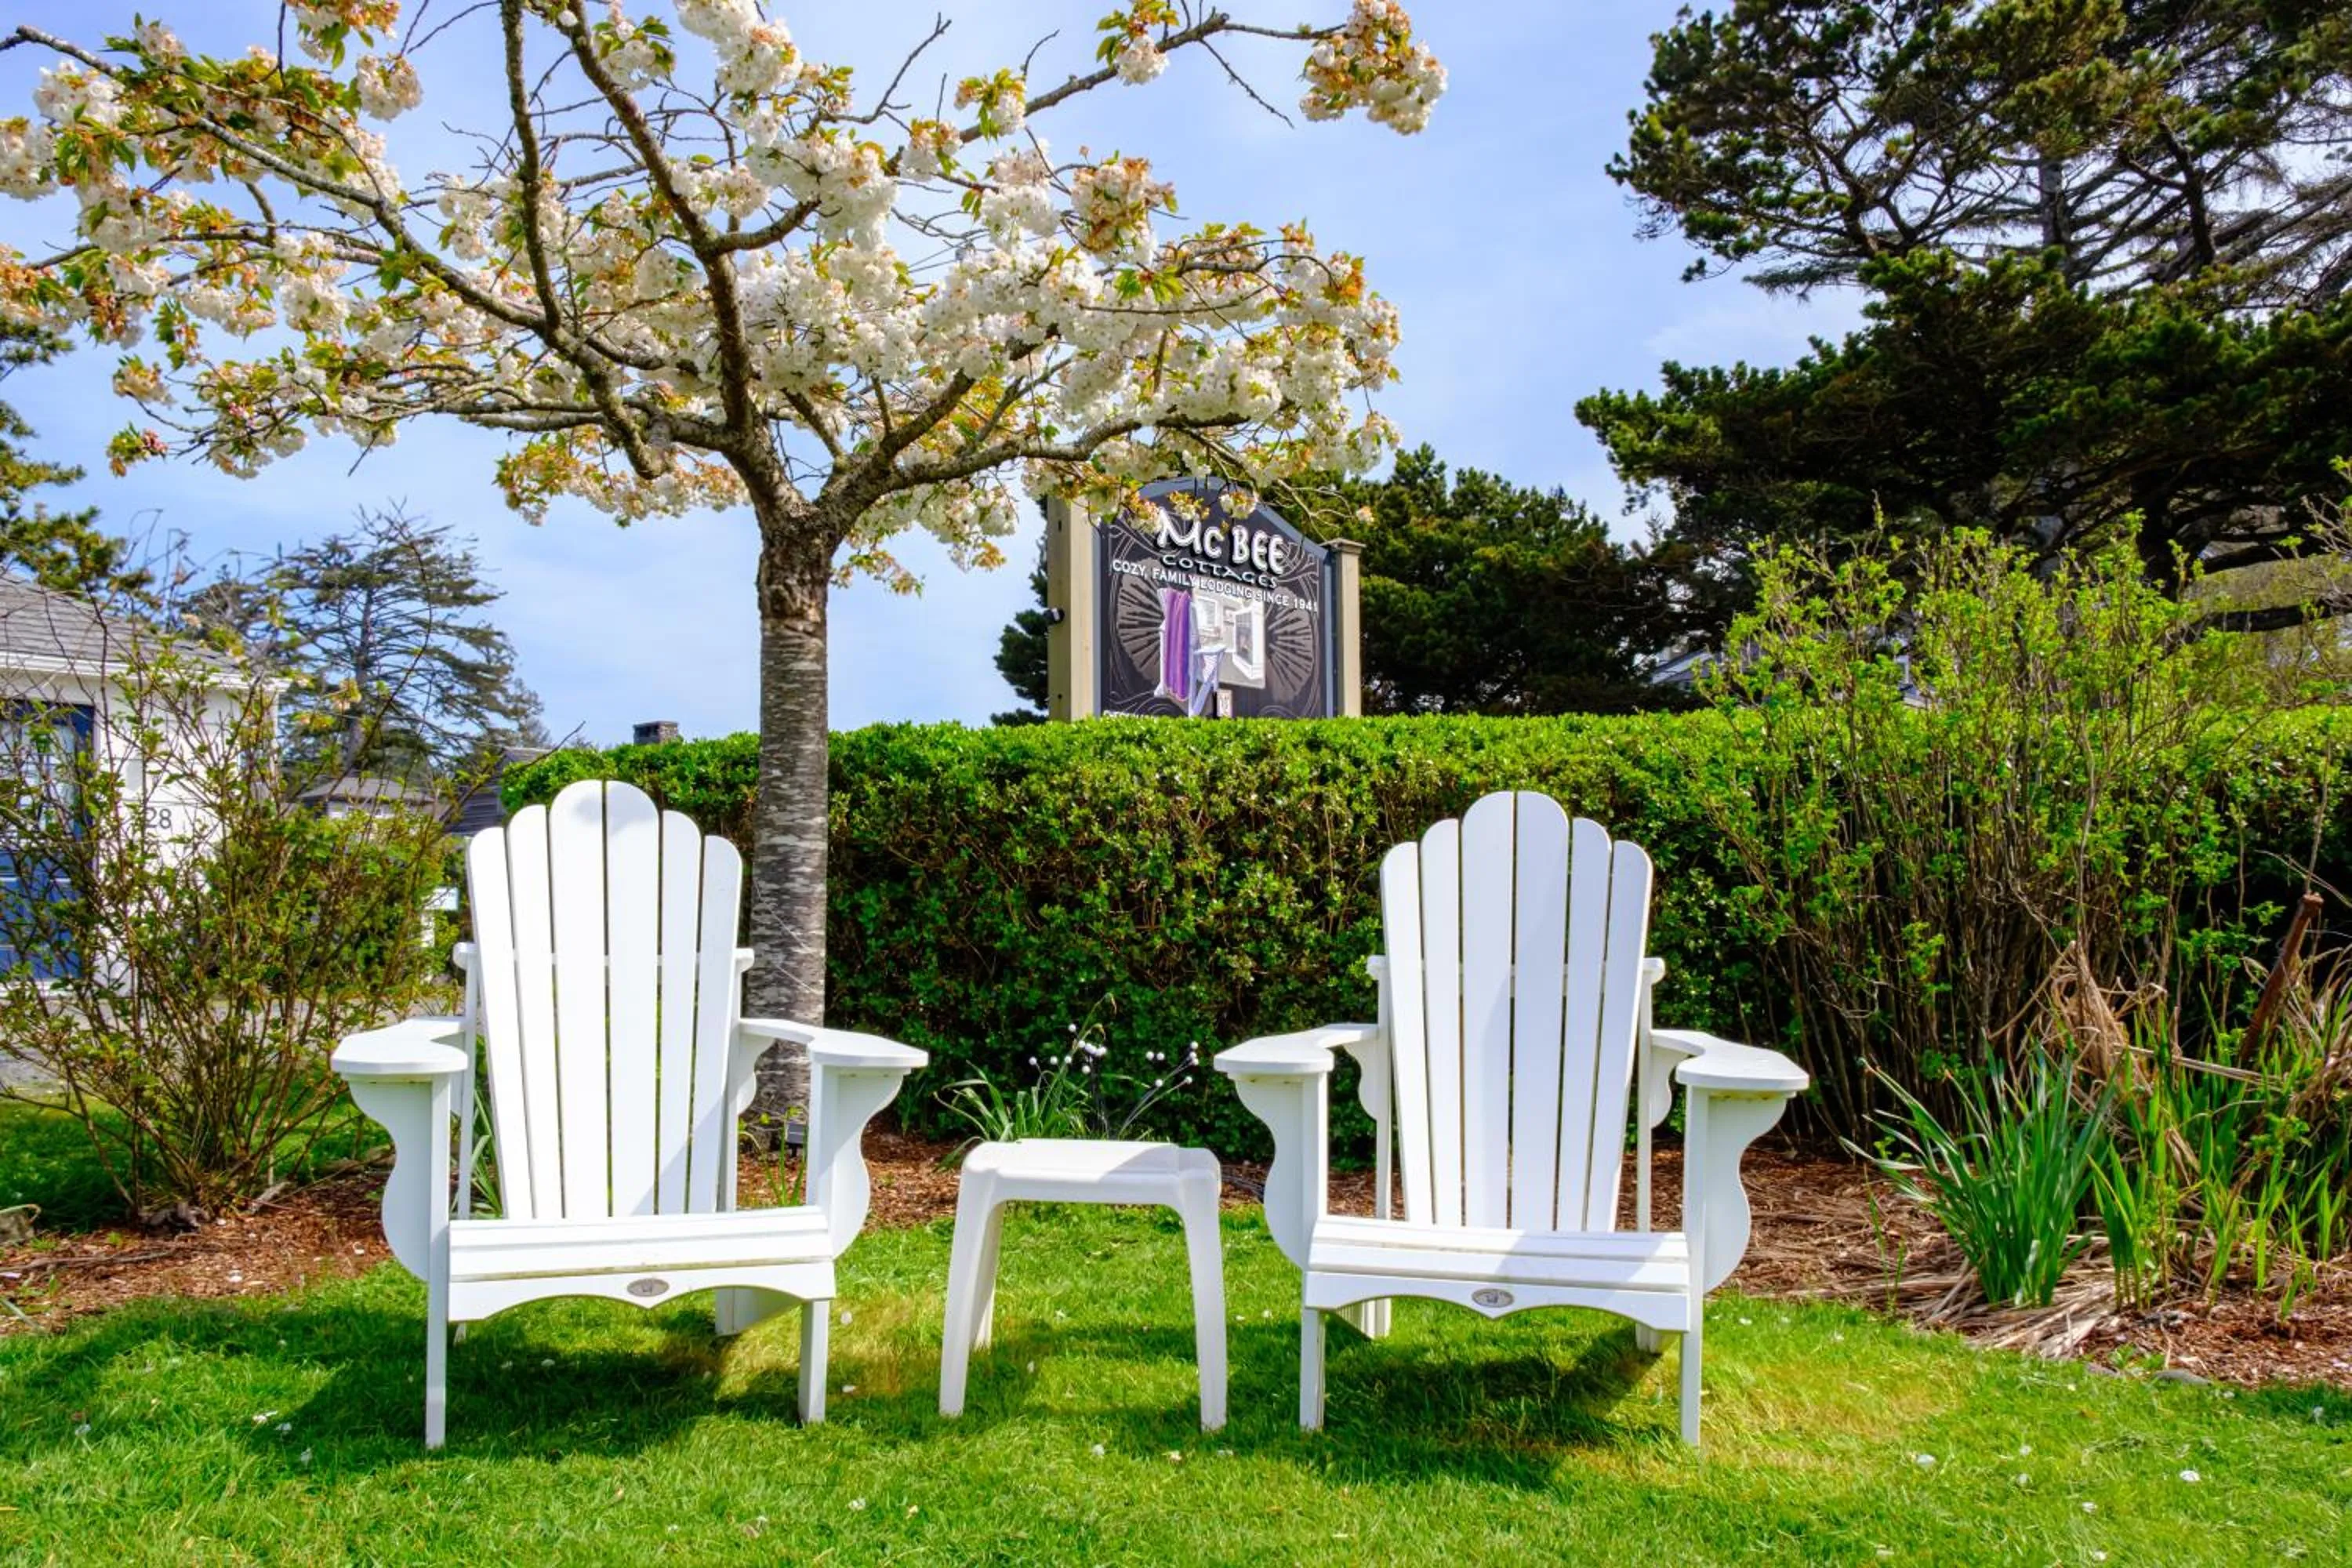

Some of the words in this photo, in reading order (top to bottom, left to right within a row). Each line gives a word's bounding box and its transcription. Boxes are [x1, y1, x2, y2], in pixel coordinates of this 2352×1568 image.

[1112, 559, 1147, 579] COZY,
[1152, 567, 1196, 586] FAMILY
[1200, 577, 1252, 599] LODGING
[1255, 590, 1290, 606] SINCE
[1294, 597, 1318, 612] 1941
[1163, 554, 1277, 589] COTTAGES
[144, 807, 172, 829] 28
